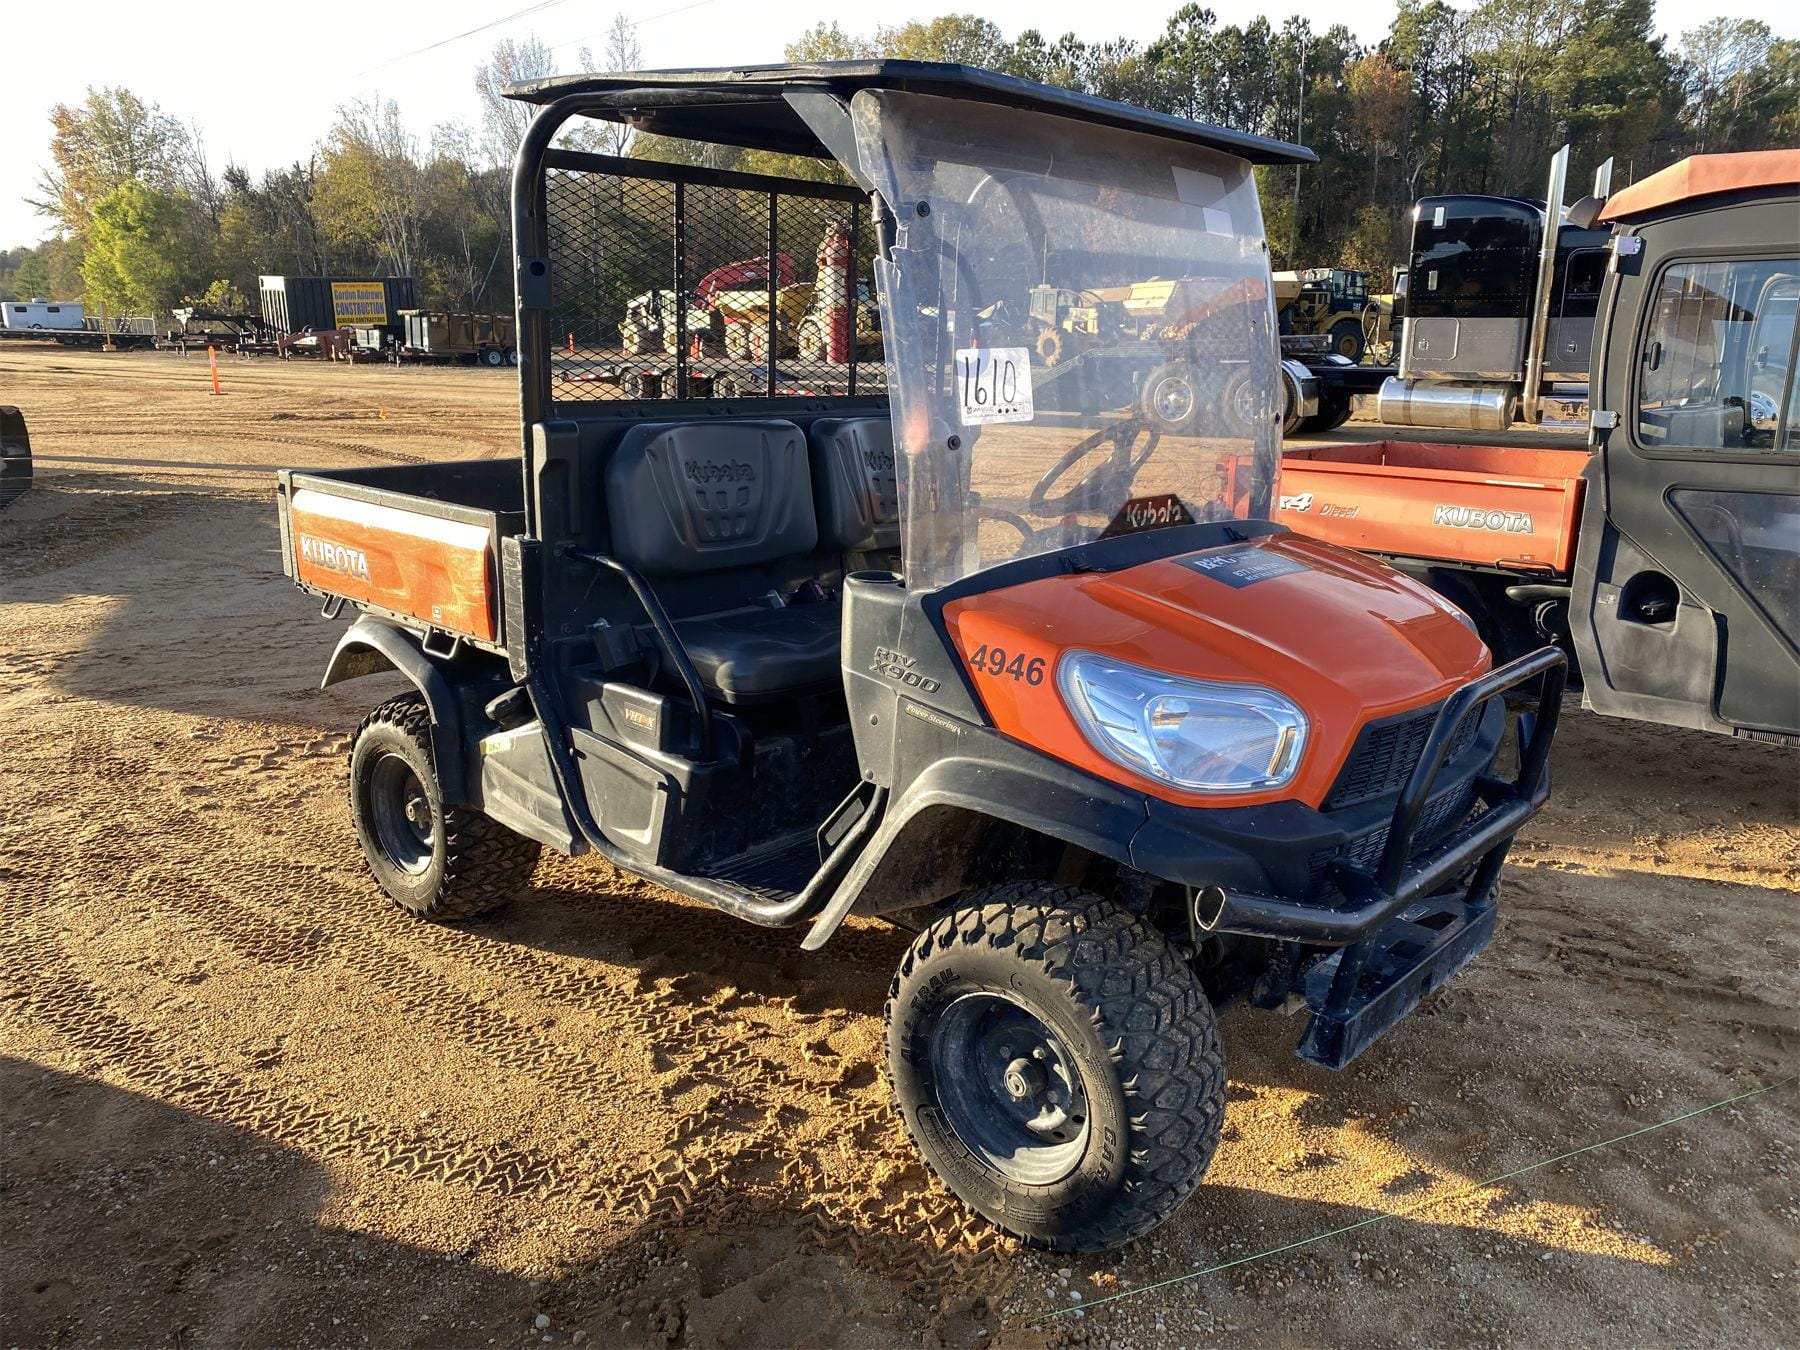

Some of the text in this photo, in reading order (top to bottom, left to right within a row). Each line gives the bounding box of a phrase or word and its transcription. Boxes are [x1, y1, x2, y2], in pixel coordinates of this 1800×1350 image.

[335, 302, 385, 315] CONSTRUCTION
[964, 356, 1017, 406] 1610
[684, 458, 755, 484] Kubota
[864, 451, 893, 471] Kub
[1126, 499, 1183, 528] Kubota
[1320, 503, 1360, 518] Diesel
[1433, 505, 1534, 535] KUBOTA
[301, 536, 370, 580] KUBOTA
[874, 646, 917, 668] RTV
[970, 644, 1046, 686] 4946
[869, 658, 941, 693] X900
[906, 703, 959, 733] Power Steering
[910, 967, 960, 1010] TRAIL
